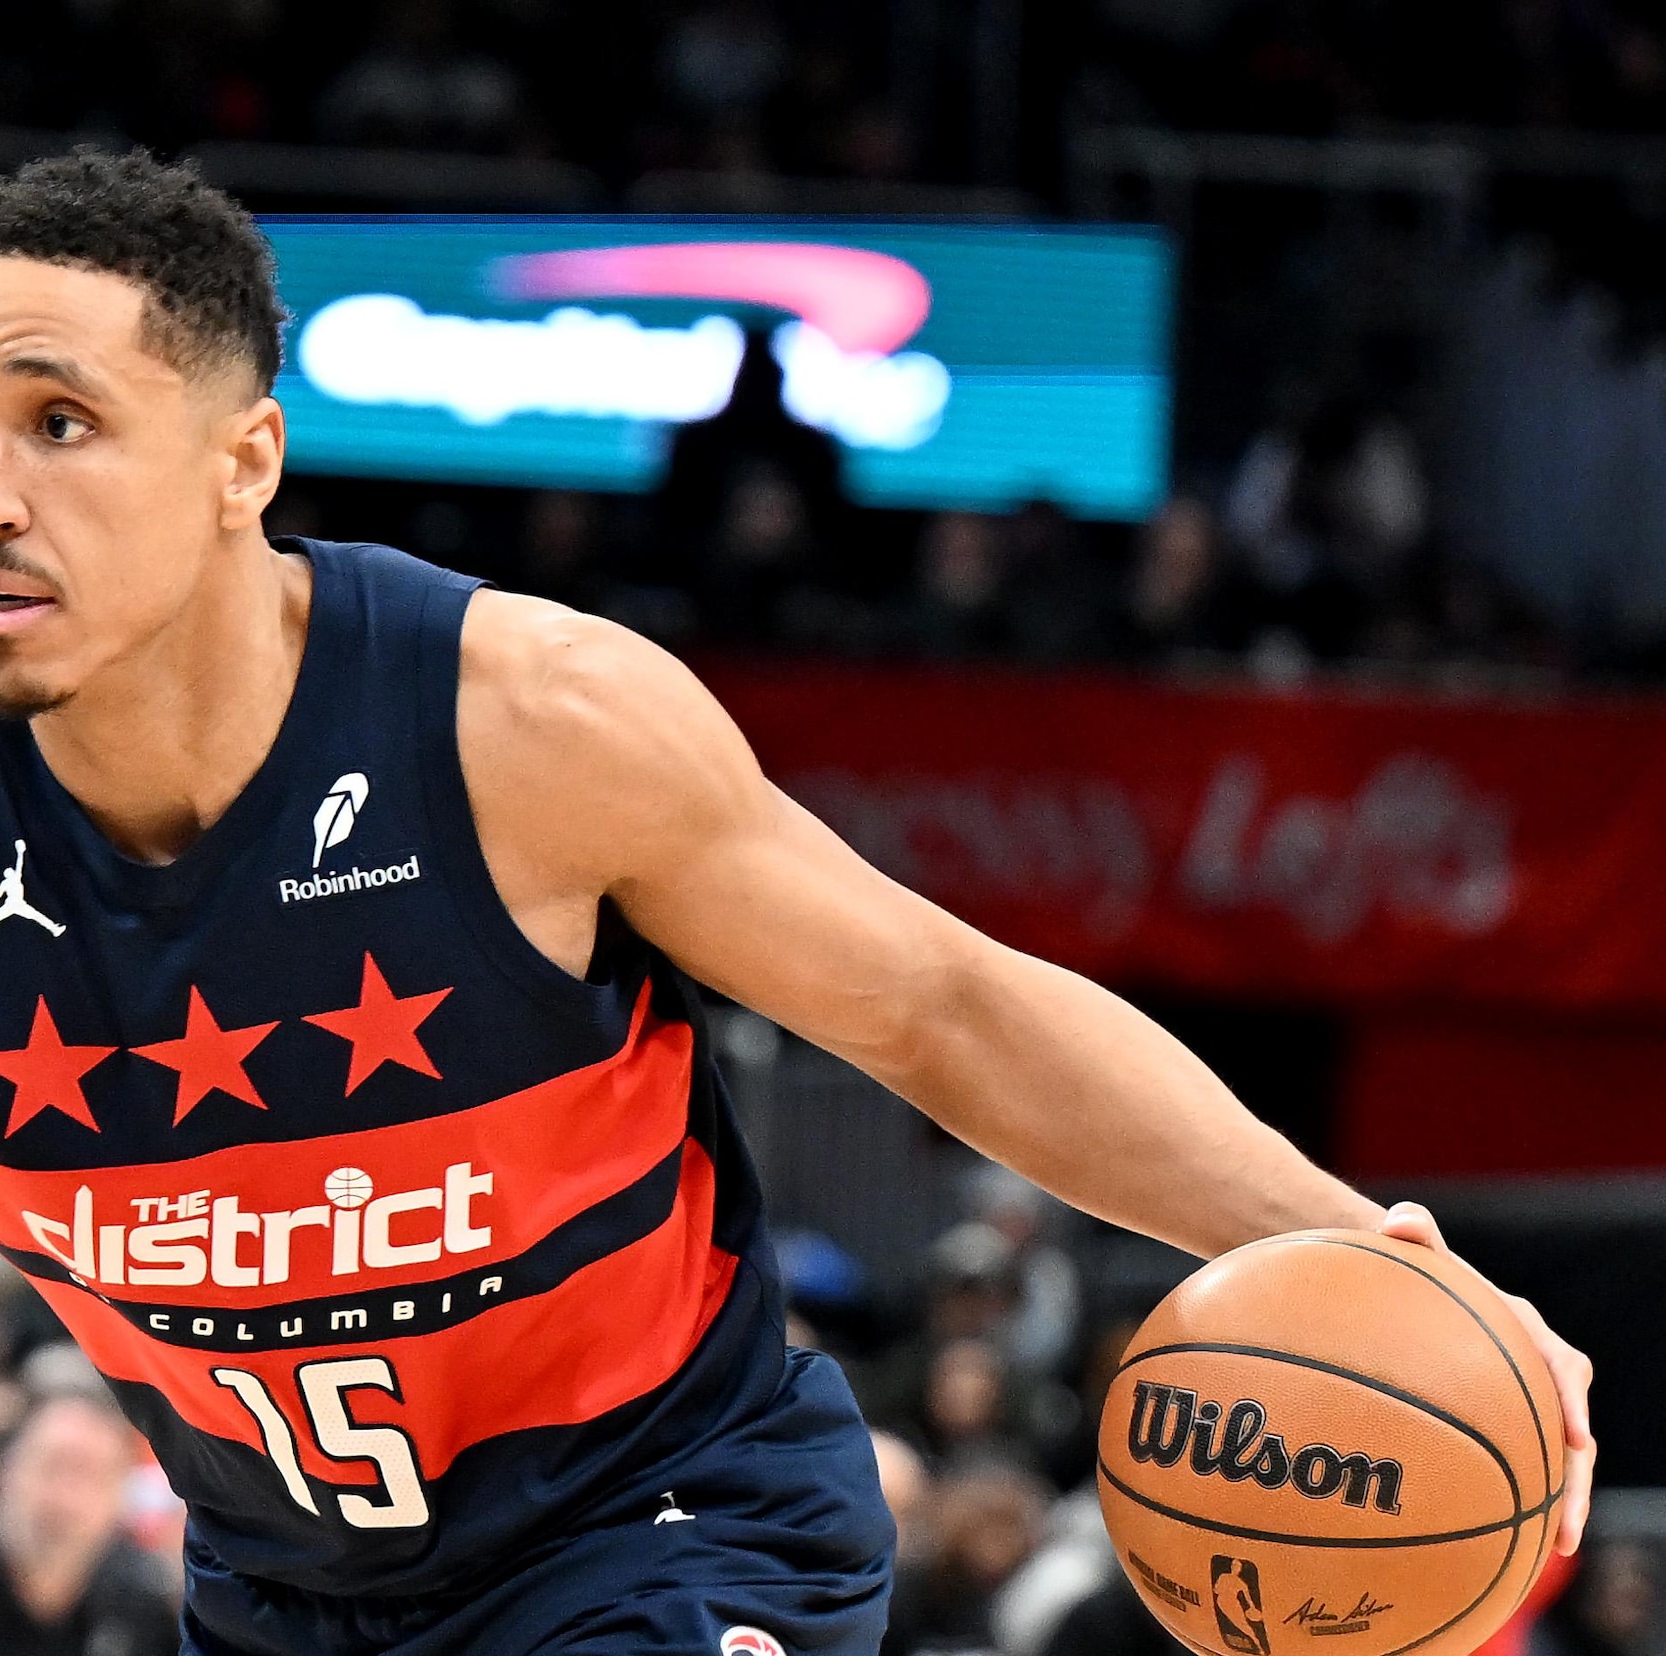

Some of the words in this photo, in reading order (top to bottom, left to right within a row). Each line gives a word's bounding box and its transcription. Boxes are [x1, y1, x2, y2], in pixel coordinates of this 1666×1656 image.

[279, 855, 421, 903] Robinhood
[130, 1189, 211, 1222] THE
[212, 1356, 431, 1530] 15
[1127, 1381, 1403, 1515] Wilson
